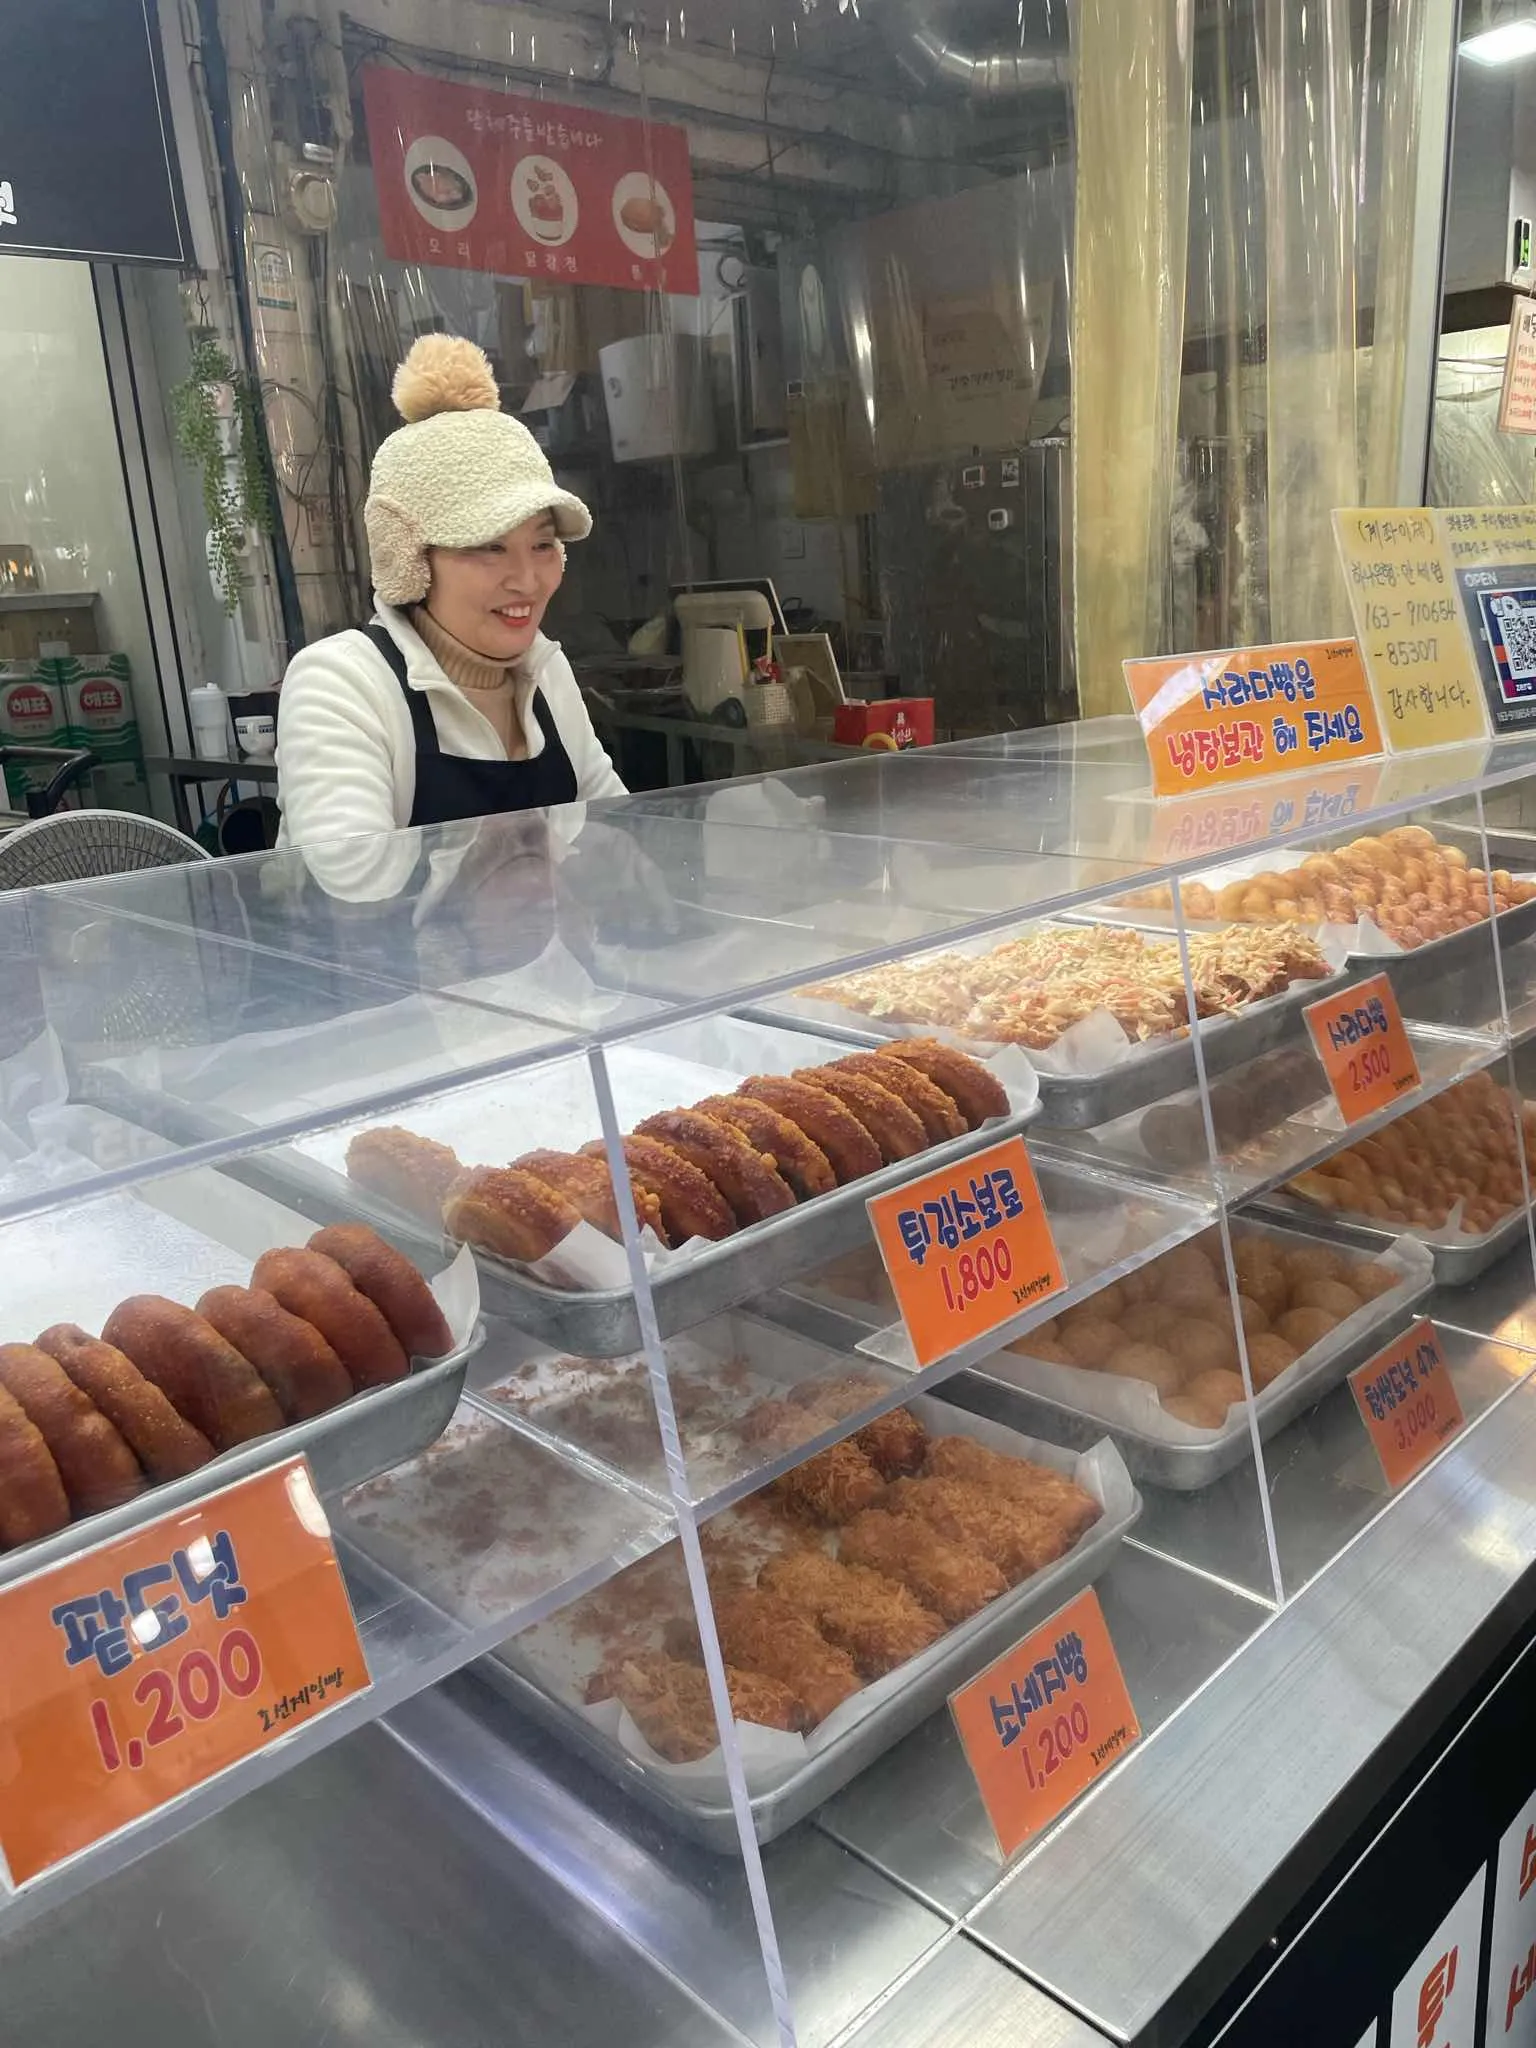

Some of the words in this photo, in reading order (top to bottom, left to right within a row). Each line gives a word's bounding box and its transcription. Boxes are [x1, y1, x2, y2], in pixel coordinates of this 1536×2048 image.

[1357, 517, 1435, 549] (계좌이체)
[1464, 571, 1498, 587] OPEN
[12, 697, 49, 714] 해표
[83, 690, 119, 707] 해표
[1202, 659, 1316, 709] 사라다빵은
[1167, 722, 1264, 776] 냉장보관
[1273, 716, 1298, 753] 해
[1304, 705, 1364, 751] 주세요
[1348, 1044, 1390, 1092] 2,500
[898, 1169, 1024, 1265] 튀김소보로
[941, 1238, 1012, 1311] 1,800
[1394, 1393, 1436, 1450] 3,000
[90, 1629, 262, 1772] 1,200
[990, 1631, 1088, 1747] 소세지빵
[1021, 1701, 1090, 1791] 1,200
